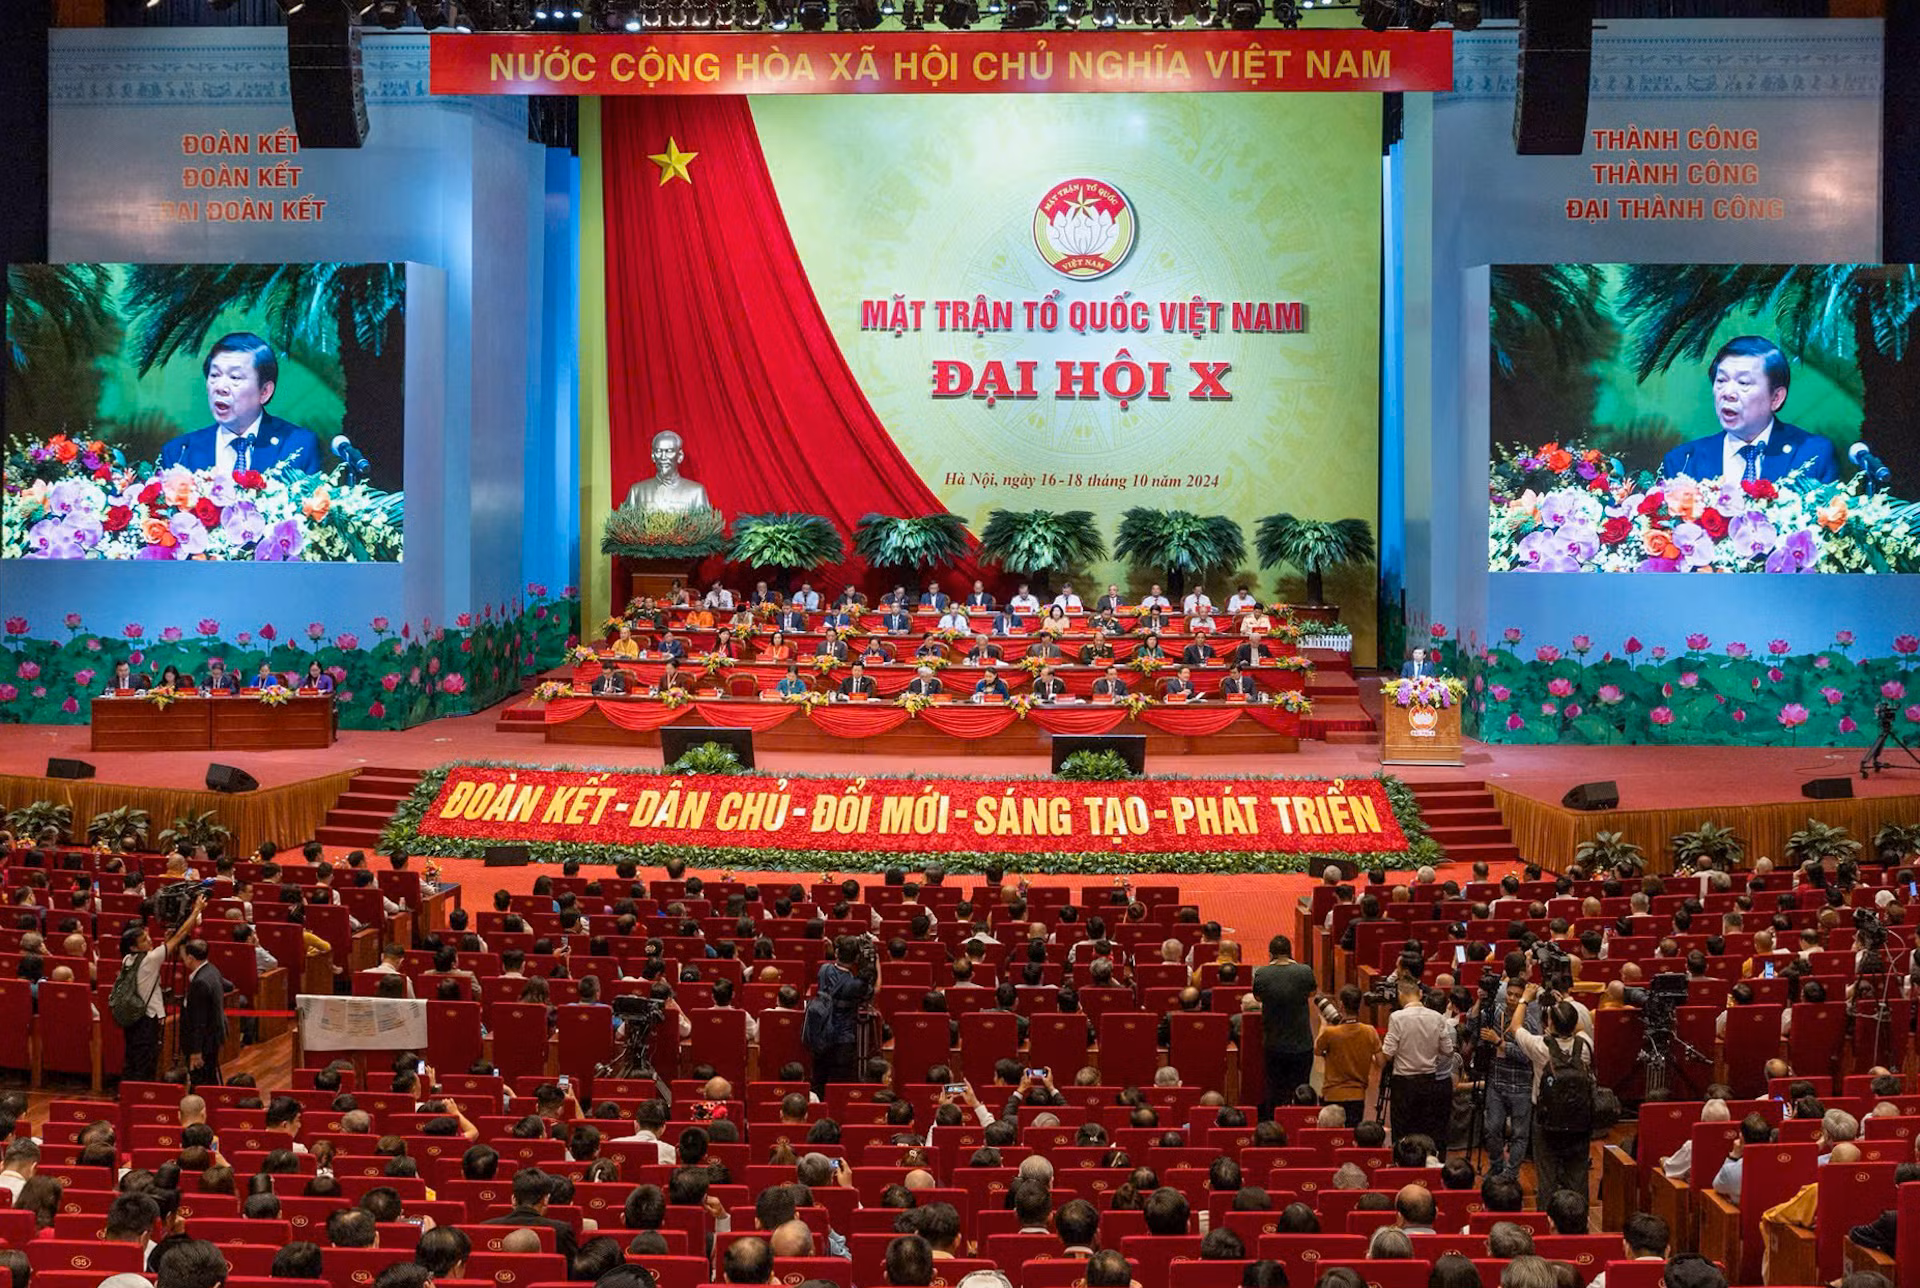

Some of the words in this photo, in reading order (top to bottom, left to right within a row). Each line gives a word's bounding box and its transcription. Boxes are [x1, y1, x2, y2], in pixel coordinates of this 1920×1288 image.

[490, 48, 596, 82] NƯỚC
[611, 46, 720, 89] CỘNG
[737, 45, 816, 82] HÒA
[829, 48, 880, 82] XÃ
[895, 44, 956, 87] HỘI
[973, 41, 1053, 81] CHỦ
[1069, 45, 1192, 81] NGHĨA
[1207, 42, 1291, 85] VIỆT
[1306, 50, 1391, 79] NAM
[182, 129, 249, 155] ĐOÀN
[257, 127, 299, 155] KẾT
[1592, 123, 1679, 151] THÀNH
[1687, 123, 1759, 151] CÔNG
[182, 162, 249, 188] ĐOÀN
[257, 160, 303, 188] KẾT
[1592, 159, 1679, 185] THÀNH
[1687, 158, 1759, 185] CÔNG
[206, 196, 274, 222] ĐOÀN
[281, 194, 327, 222] KẾT
[1565, 199, 1609, 224] ĐẠI
[1617, 194, 1704, 220] THÀNH
[1712, 193, 1784, 221] CÔNG
[861, 293, 926, 336] MẶT
[936, 293, 1013, 337] TRẬN
[1023, 289, 1061, 330] TỔ
[1068, 290, 1149, 334] QUỐC
[1159, 295, 1223, 338] VIỆT
[1231, 301, 1304, 331] NAM
[932, 360, 1039, 407] ĐẠI
[1055, 347, 1171, 409] HỘI
[1188, 361, 1232, 399] X
[944, 472, 966, 486] Hà
[969, 472, 999, 487] Nội,
[1002, 474, 1036, 489] ngày
[1087, 473, 1127, 490] tháng
[1132, 474, 1148, 488] 10
[1151, 475, 1182, 488] năm
[1185, 474, 1219, 489] 2024
[440, 773, 546, 823] ĐOÀN
[541, 773, 617, 825] KẾT
[629, 780, 711, 829] DÂN
[716, 778, 791, 831] CHỦ
[810, 777, 873, 834] ĐỔI
[879, 785, 950, 835] MỚI
[973, 787, 1072, 836] SÁNG
[1083, 796, 1150, 844] TẠO
[1171, 785, 1260, 836] PHÁT
[1271, 778, 1382, 834] TRIỂN
